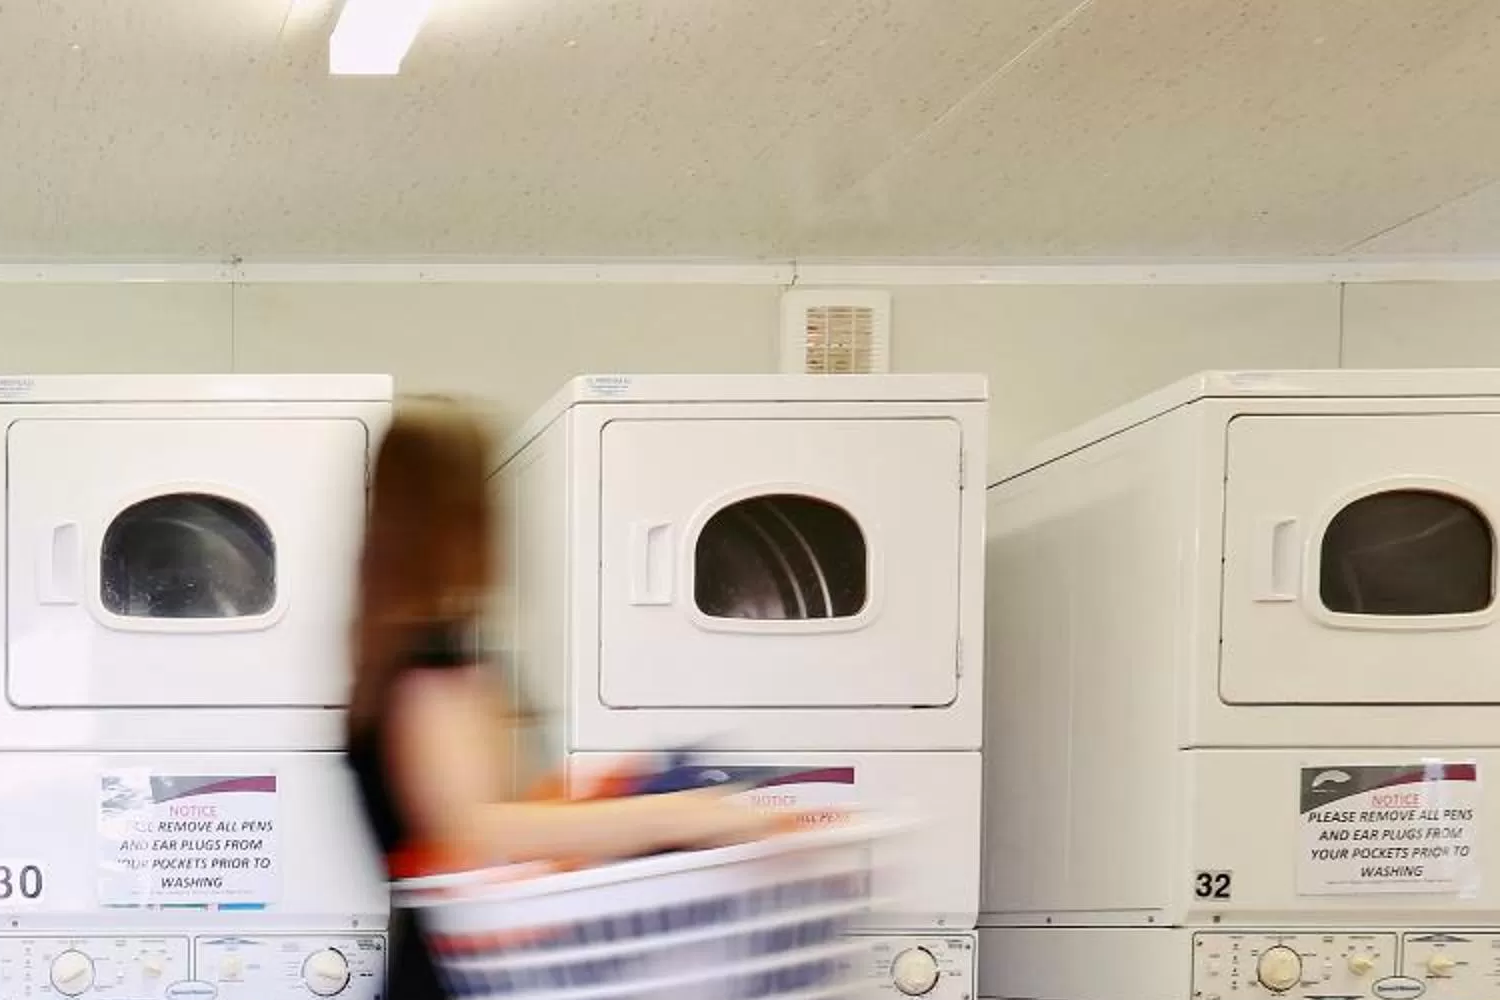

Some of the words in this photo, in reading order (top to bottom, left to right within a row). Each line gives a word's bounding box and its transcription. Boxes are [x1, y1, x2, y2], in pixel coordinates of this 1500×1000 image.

[1372, 794, 1420, 807] NOTICE
[169, 805, 217, 817] NOTICE
[1308, 811, 1356, 823] PLEASE
[1360, 810, 1416, 822] REMOVE
[1419, 809, 1439, 821] ALL
[1443, 808, 1473, 821] PENS
[158, 821, 213, 833] REMOVE
[216, 821, 237, 833] ALL
[241, 820, 273, 832] PENS
[1319, 829, 1349, 841] AND
[1353, 829, 1379, 840] EAR
[1382, 828, 1423, 840] PLUGS
[1425, 827, 1464, 839] FROM
[152, 839, 177, 850] EAR
[180, 839, 221, 851] PLUGS
[224, 839, 264, 851] FROM
[1311, 848, 1349, 860] YOUR
[1351, 847, 1409, 859] POCKETS
[1412, 846, 1449, 858] PRIOR
[1453, 845, 1470, 858] TO
[152, 858, 207, 869] POCKETS
[211, 857, 251, 869] PRIOR
[253, 857, 271, 869] TO
[1360, 865, 1424, 877] WASHING
[161, 877, 223, 889] WASHING
[1196, 873, 1230, 898] 32
